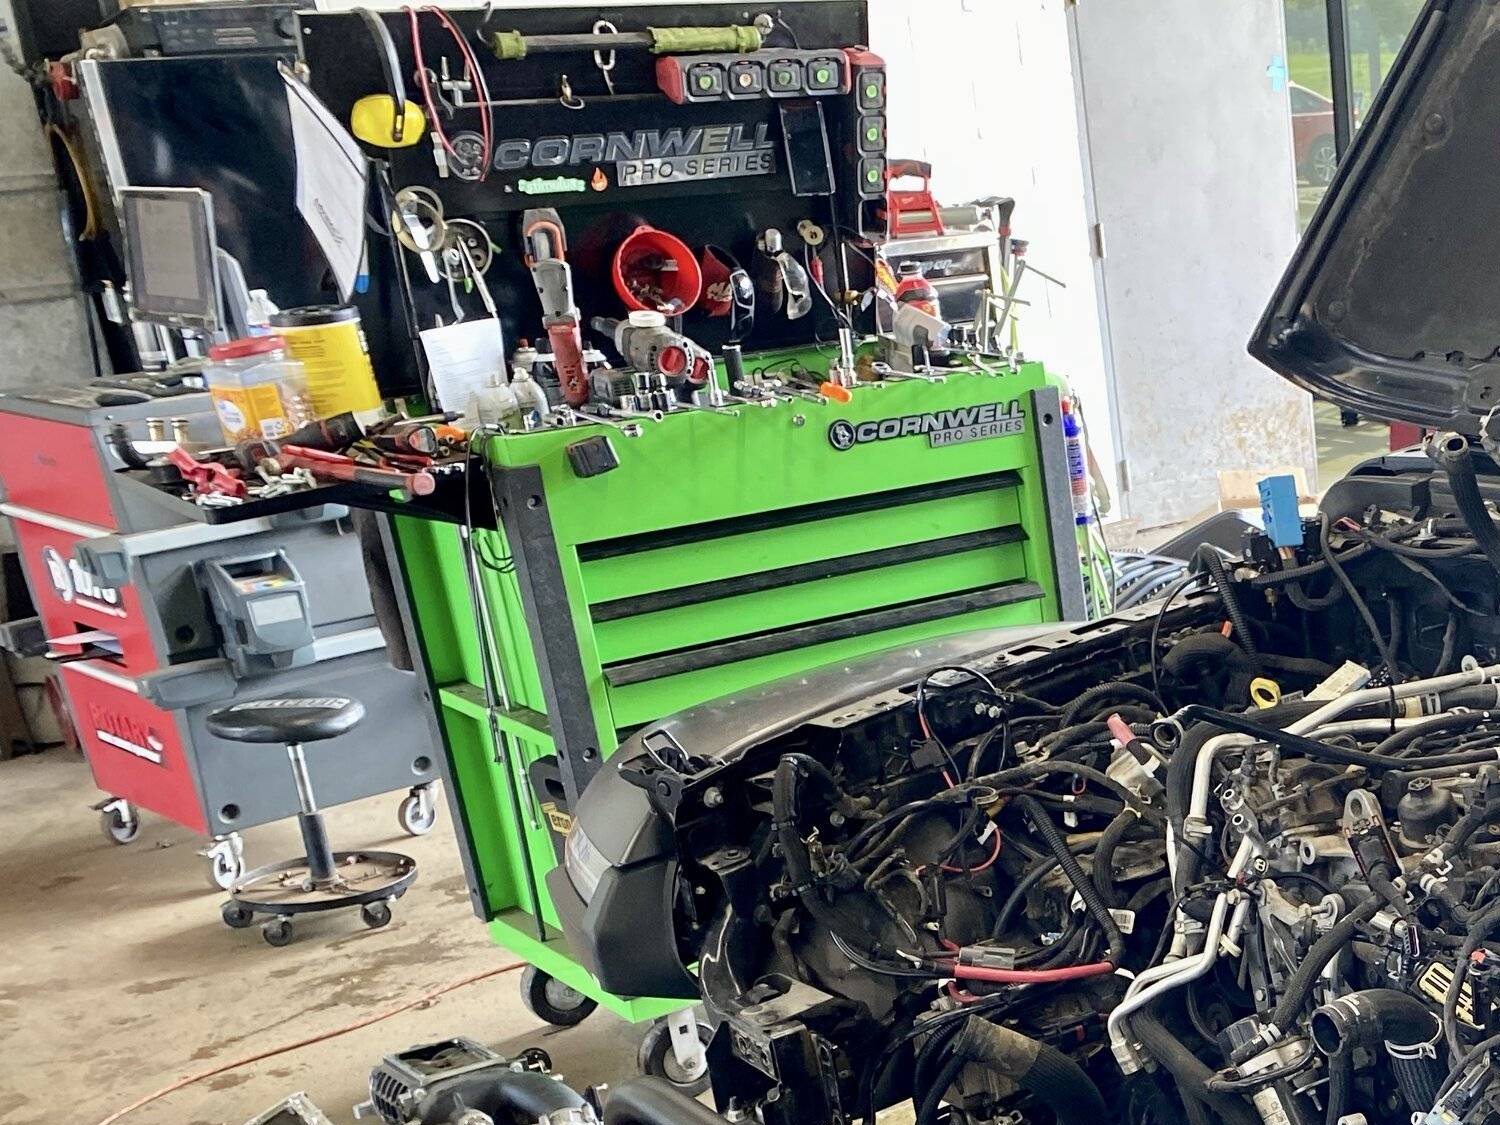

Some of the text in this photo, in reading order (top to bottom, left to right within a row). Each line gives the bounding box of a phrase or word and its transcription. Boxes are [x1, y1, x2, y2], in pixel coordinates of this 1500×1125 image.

[494, 122, 775, 169] CORNWELL
[622, 153, 773, 182] PRO SERIES
[856, 400, 1025, 444] CORNWELL
[933, 420, 1022, 444] PRO SERIES
